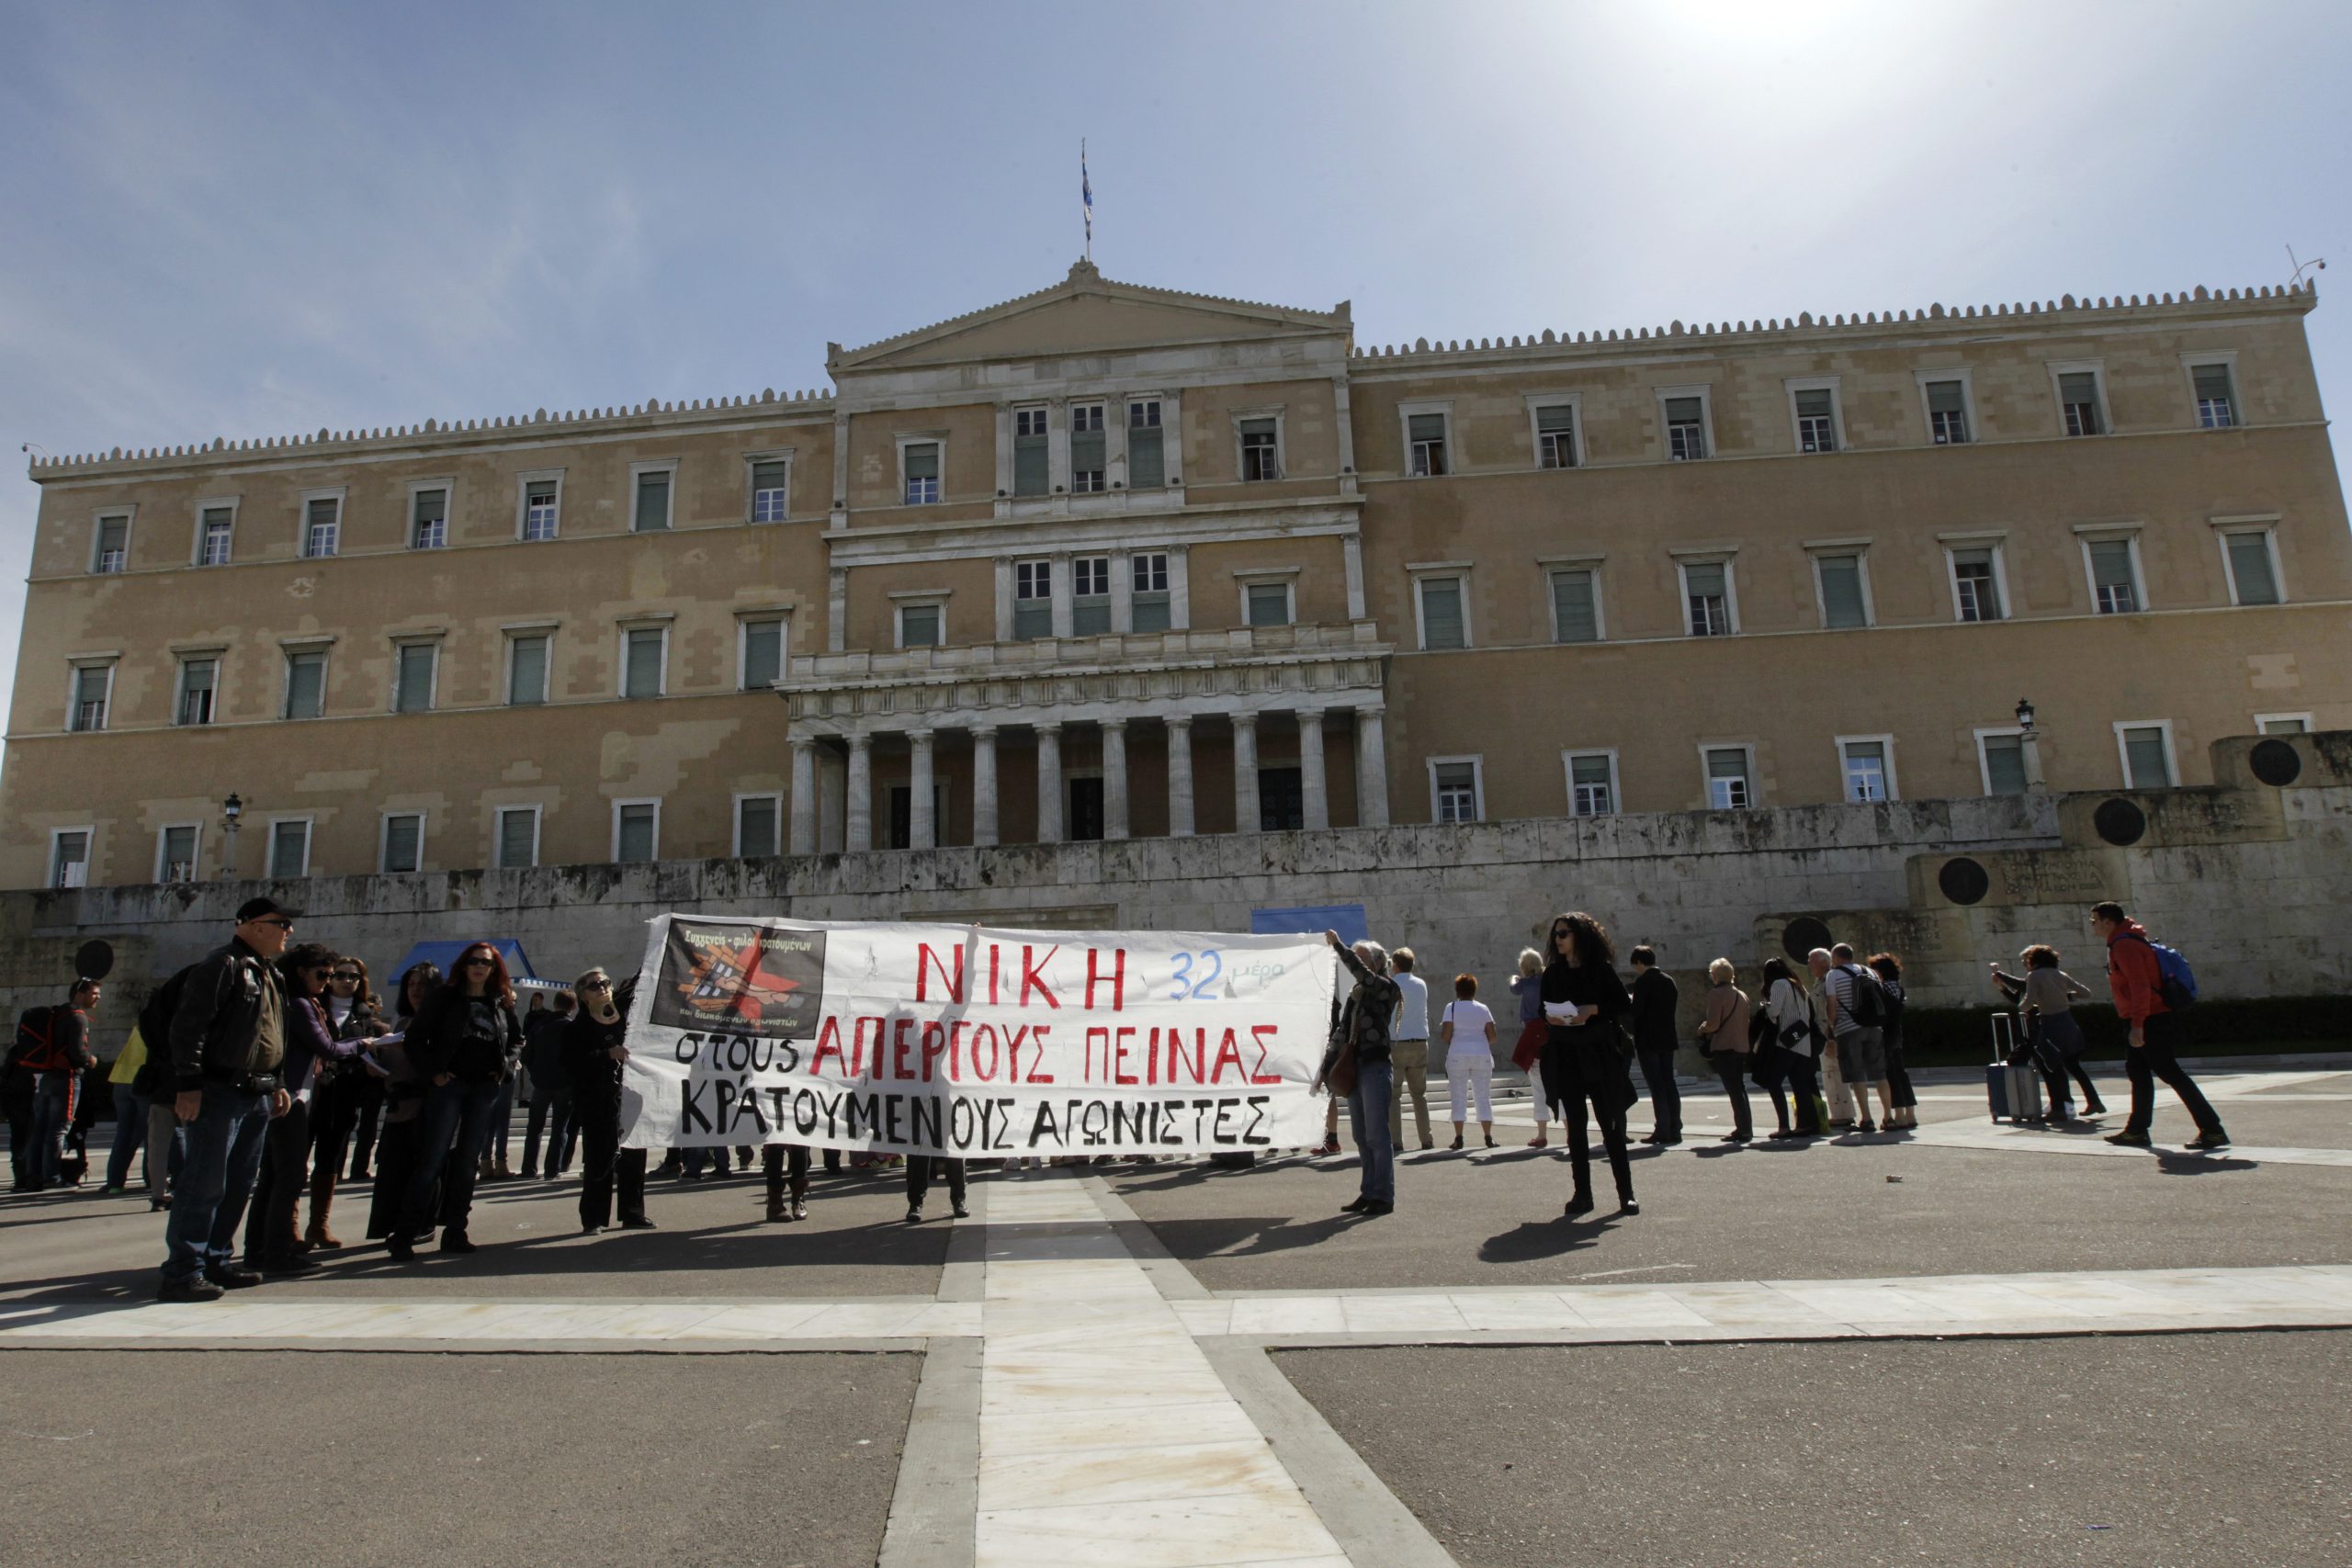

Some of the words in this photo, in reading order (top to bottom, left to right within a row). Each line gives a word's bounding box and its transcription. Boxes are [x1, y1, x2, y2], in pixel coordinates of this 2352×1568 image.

[915, 942, 1126, 1012] ΝΙΚΗ
[1170, 949, 1223, 1001] 32
[808, 1015, 1055, 1084] ΑΠΕΡΓΟΥΣ
[1084, 1025, 1283, 1085] ΠΕΙΝΑΣ
[1027, 1095, 1272, 1148] ΑΓΩΝΙΣΤΕΣ
